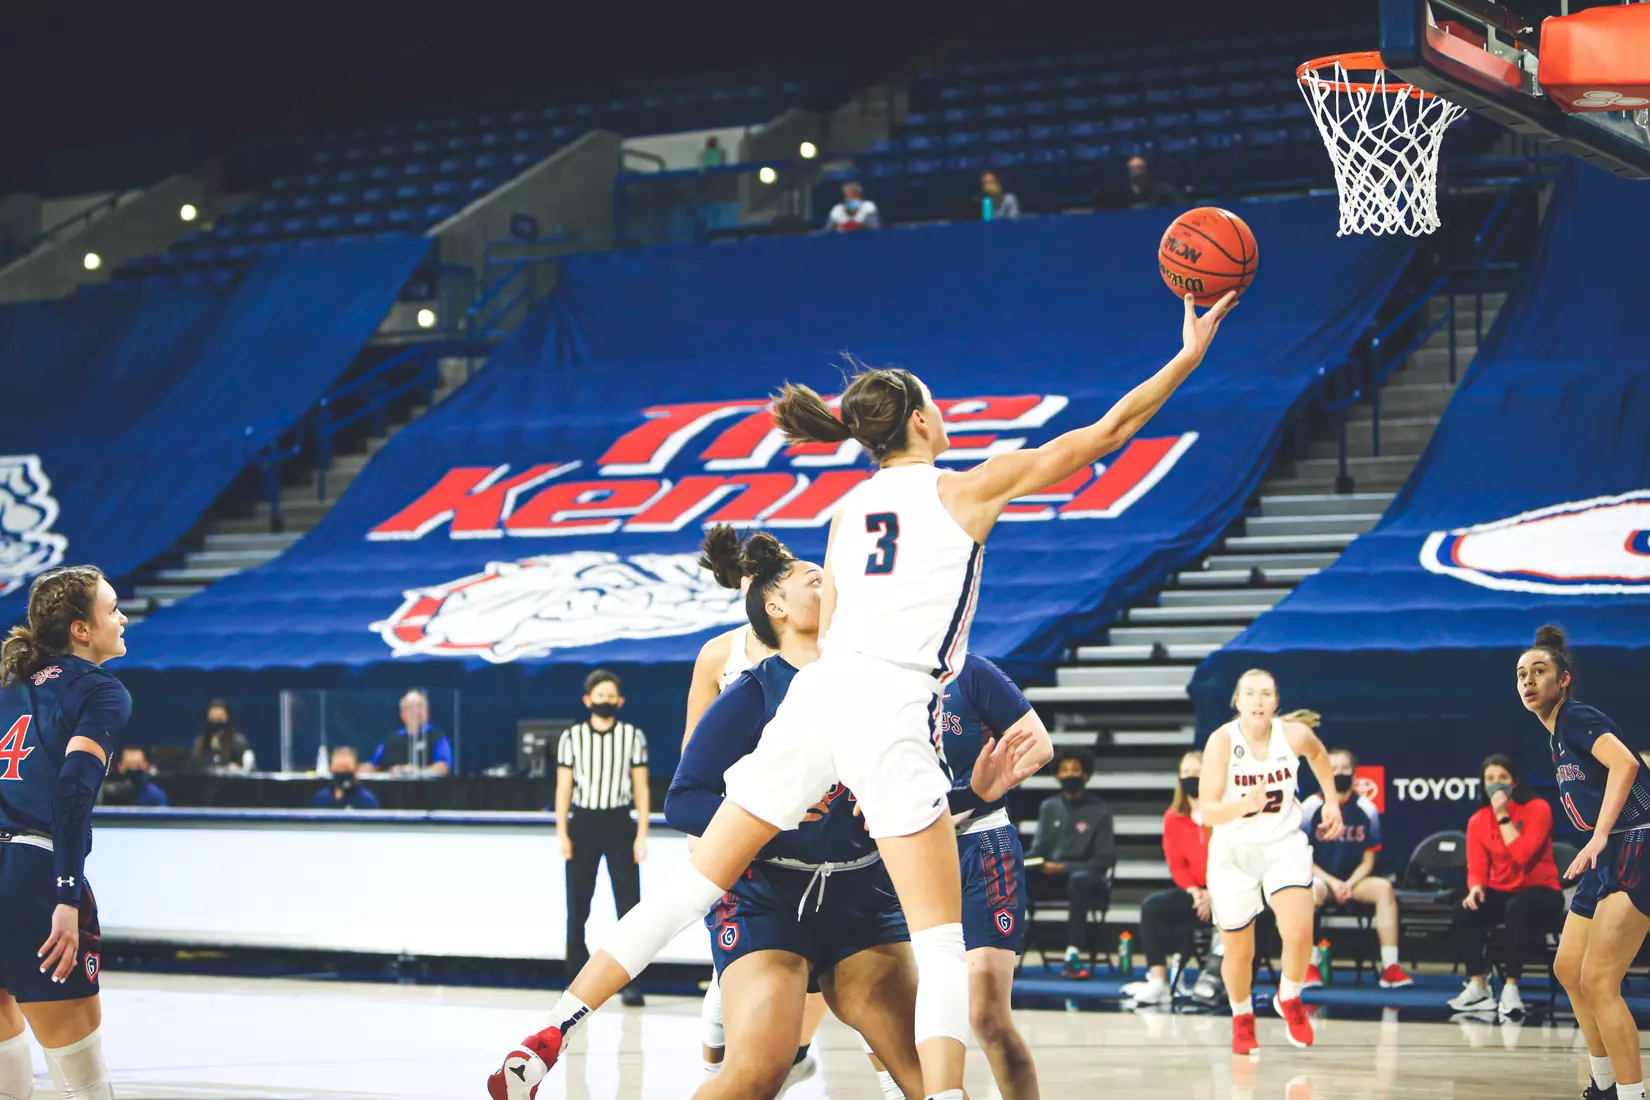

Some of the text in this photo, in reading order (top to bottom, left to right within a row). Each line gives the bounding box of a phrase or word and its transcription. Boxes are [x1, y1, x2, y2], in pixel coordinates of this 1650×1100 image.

[1160, 263, 1205, 293] Wilso
[864, 511, 900, 576] 3
[0, 714, 35, 781] 4
[1392, 777, 1481, 801] TOYOT
